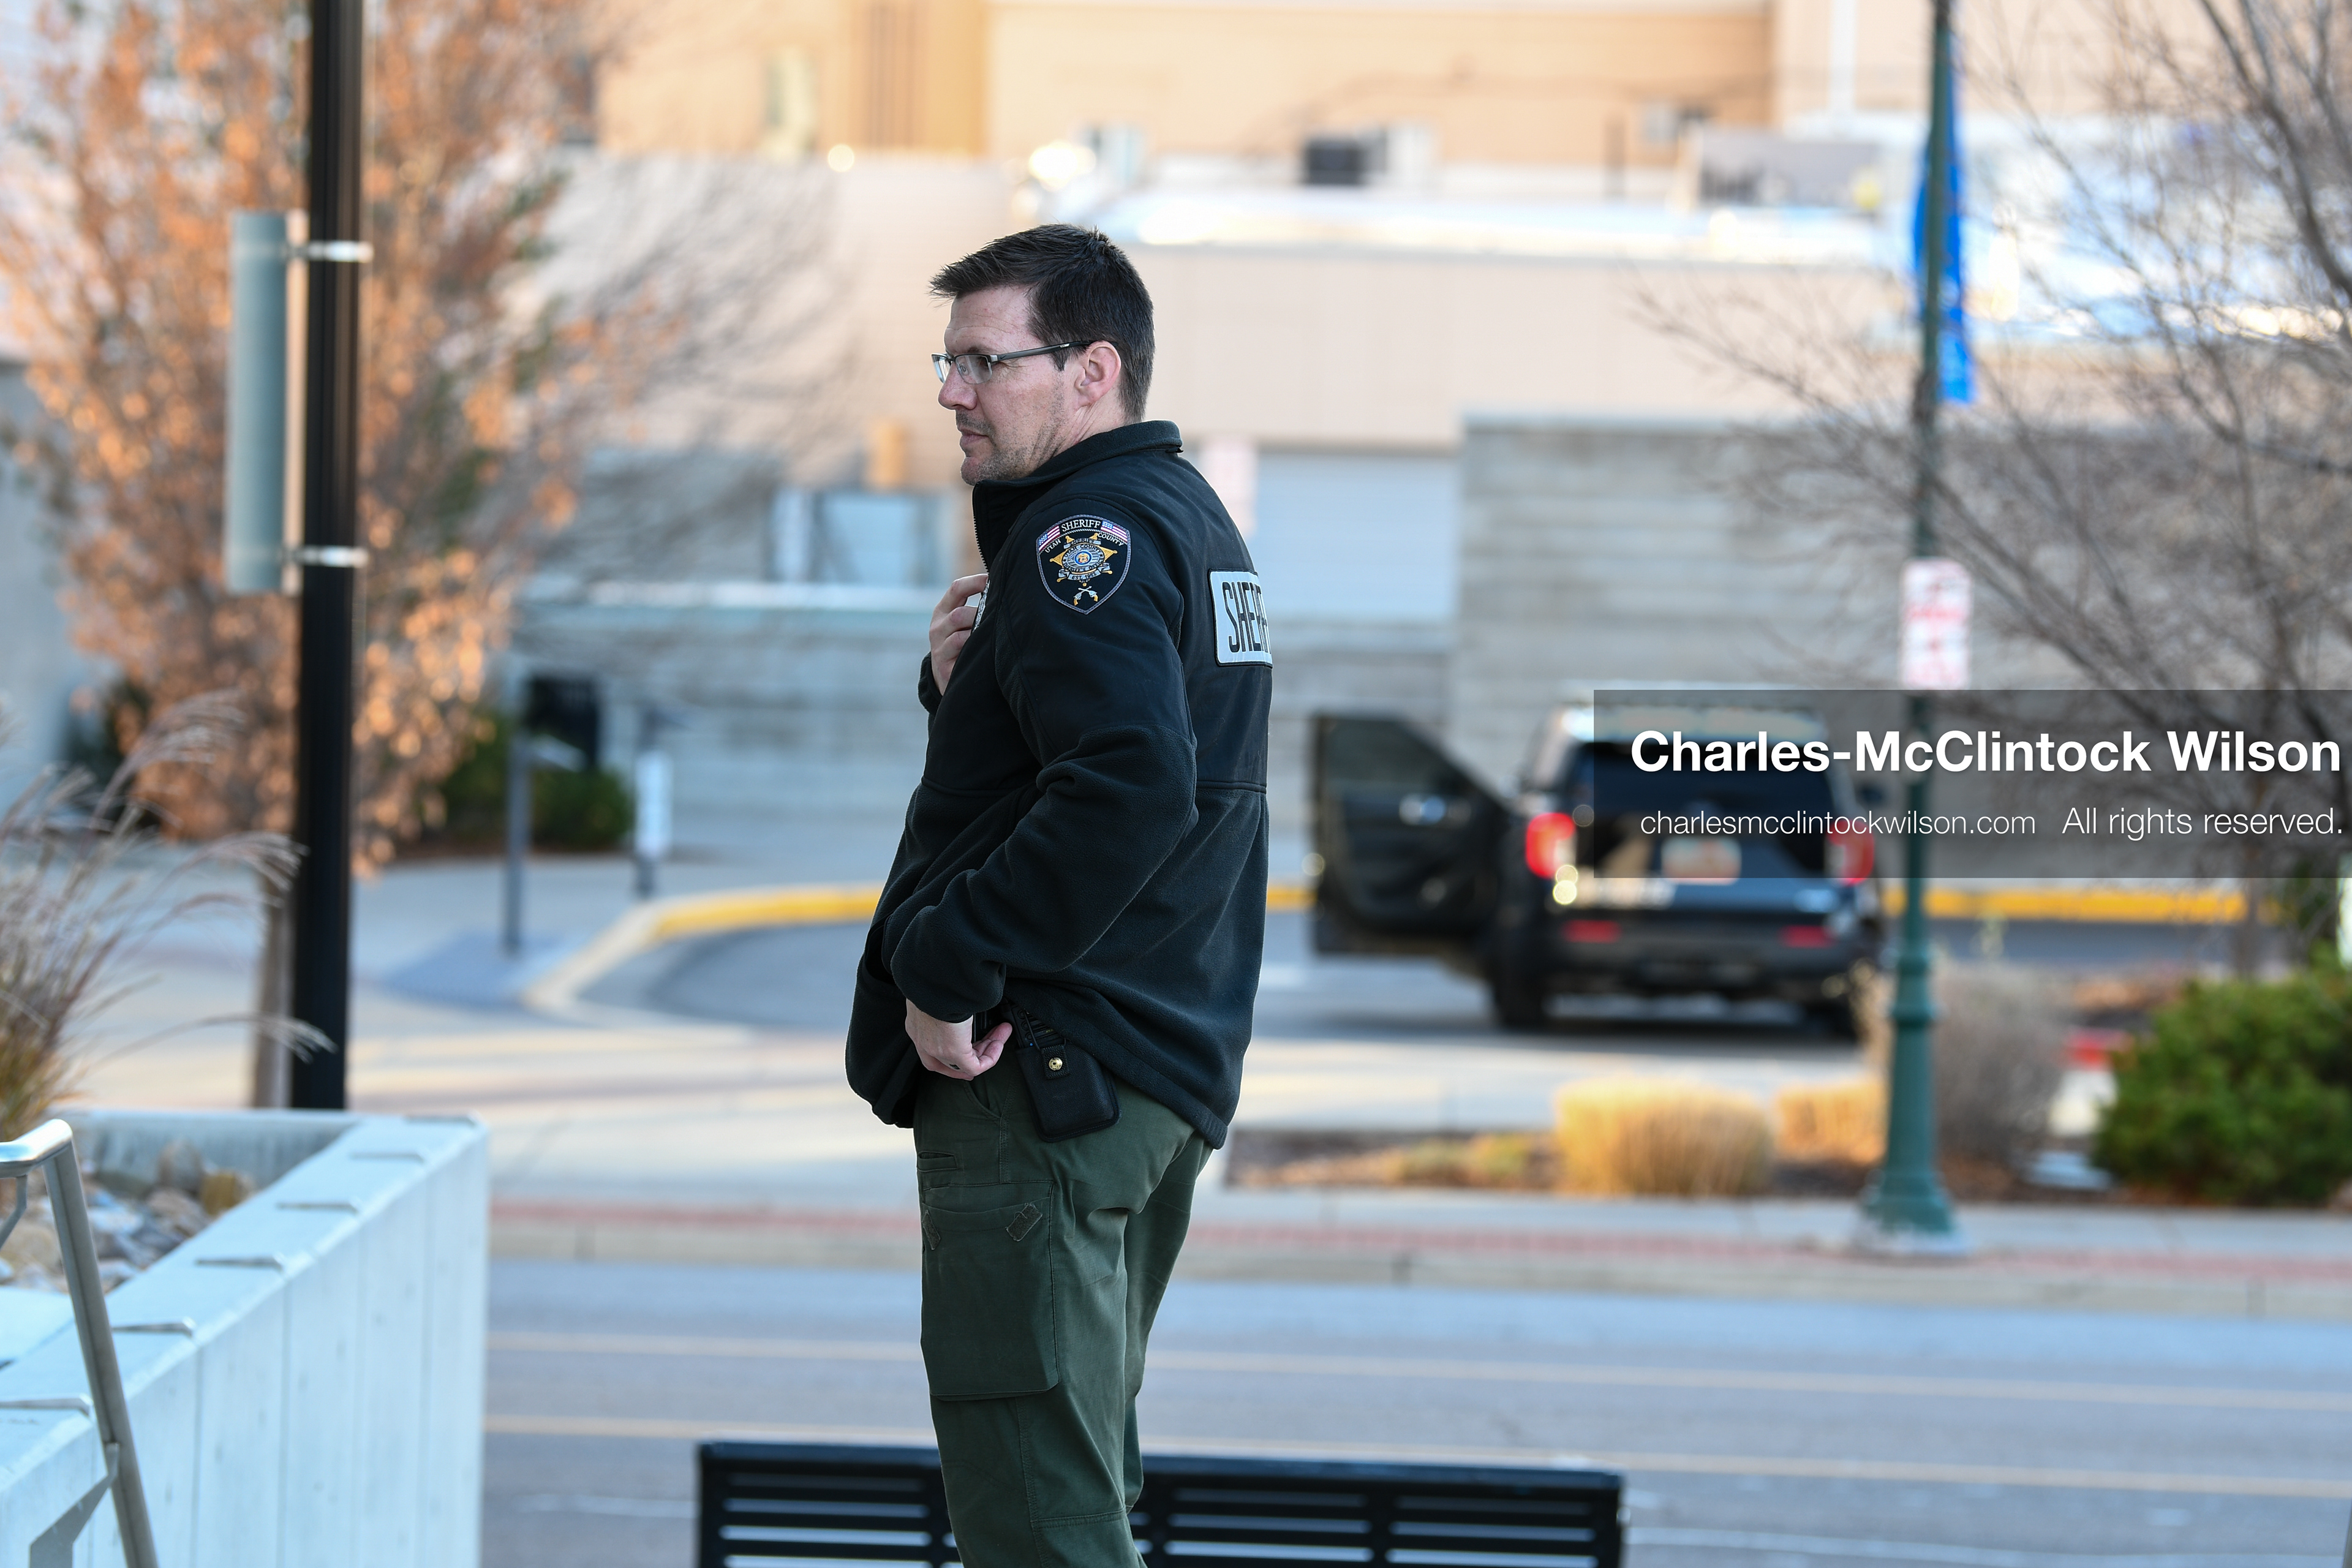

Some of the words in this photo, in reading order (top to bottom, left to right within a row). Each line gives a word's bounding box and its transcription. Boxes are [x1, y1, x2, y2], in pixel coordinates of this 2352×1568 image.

[1061, 519, 1101, 532] SHERIFF
[1045, 539, 1061, 554] UTAH
[1097, 532, 1125, 547] COUNTY
